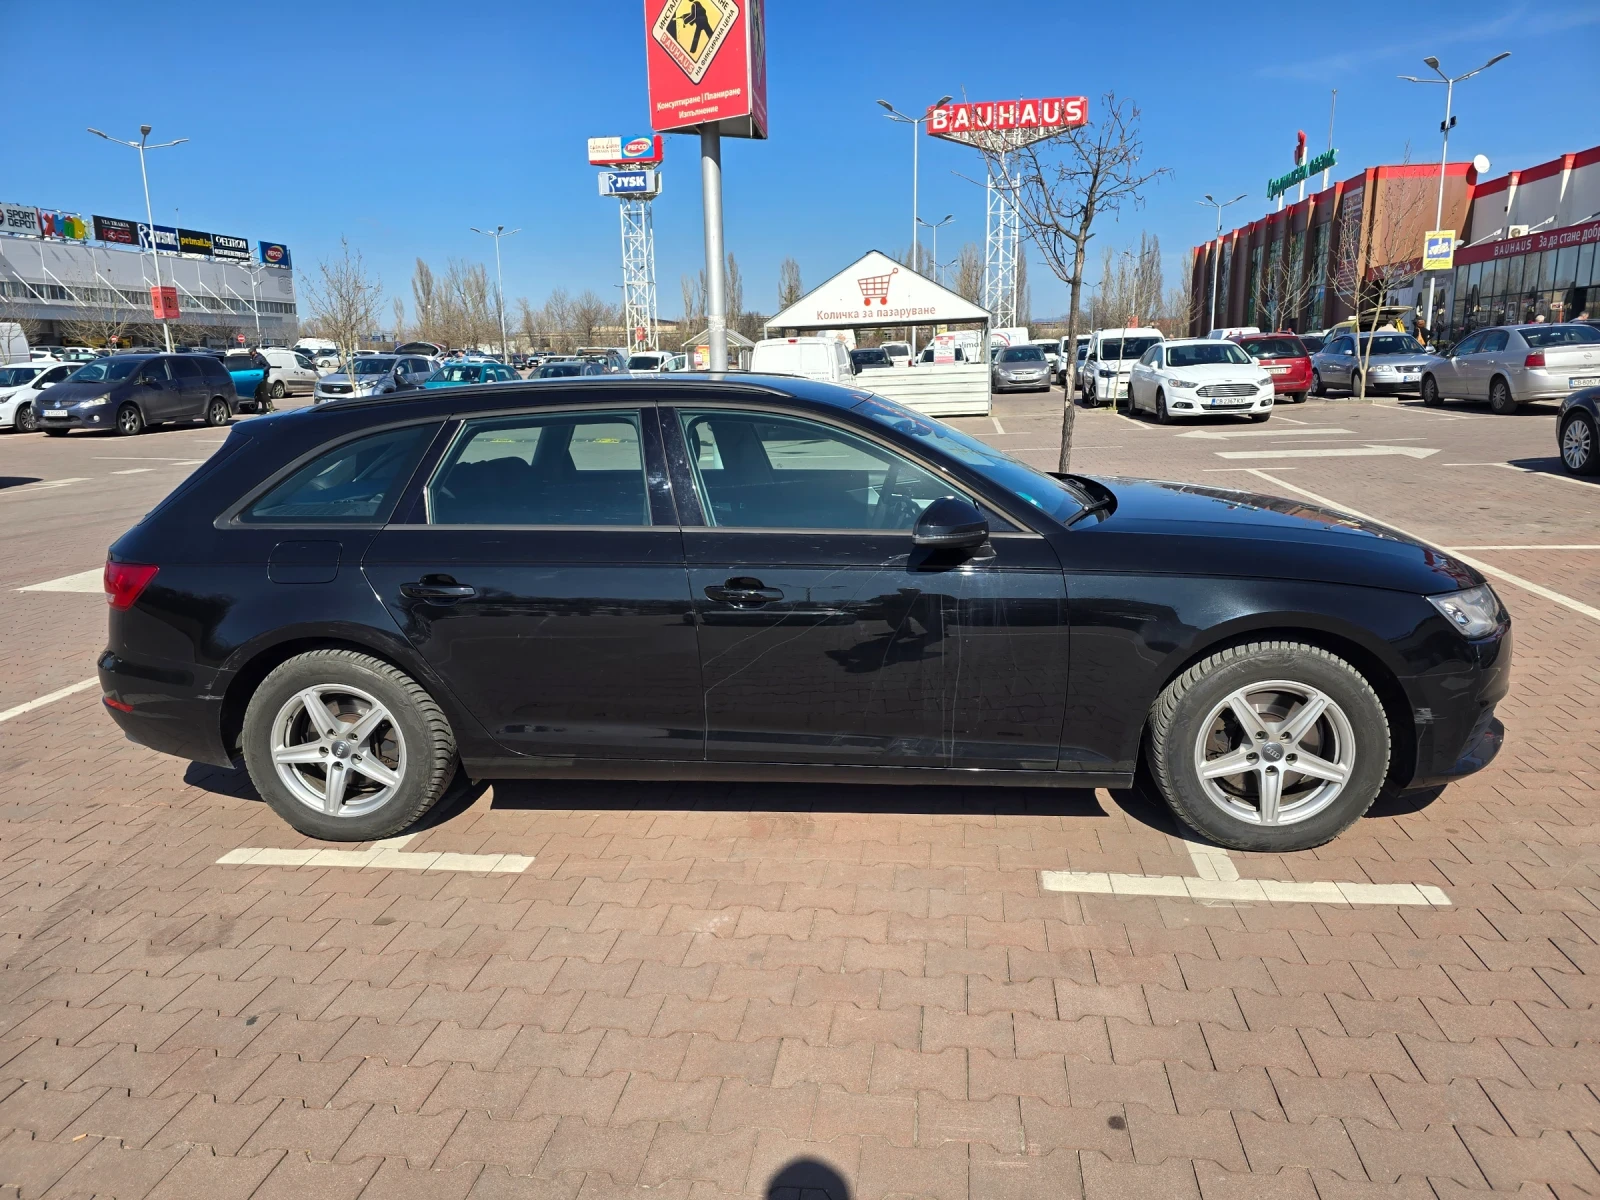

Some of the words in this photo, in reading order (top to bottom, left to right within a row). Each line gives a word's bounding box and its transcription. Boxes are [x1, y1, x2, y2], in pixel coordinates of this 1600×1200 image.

[695, 67, 703, 76] НА
[701, 27, 724, 66] ФИКСИРАНА
[723, 9, 735, 29] ЦЕНА
[661, 32, 695, 74] BAUHAUS
[657, 95, 701, 111] Консултиране
[704, 87, 741, 101] Планиране
[678, 105, 719, 119] Изпълнение
[932, 101, 1082, 129] BAUHAUS
[616, 176, 645, 187] JYSK
[6, 209, 35, 220] SPORT
[8, 218, 36, 229] DEPOT
[180, 237, 213, 249] petmall.bg
[1539, 235, 1547, 247] За
[1548, 235, 1558, 248] да
[1560, 231, 1580, 244] стане
[1494, 240, 1532, 256] BAUHAUS
[817, 310, 860, 320] Количка
[862, 310, 873, 318] за
[877, 306, 936, 318] пазаруване
